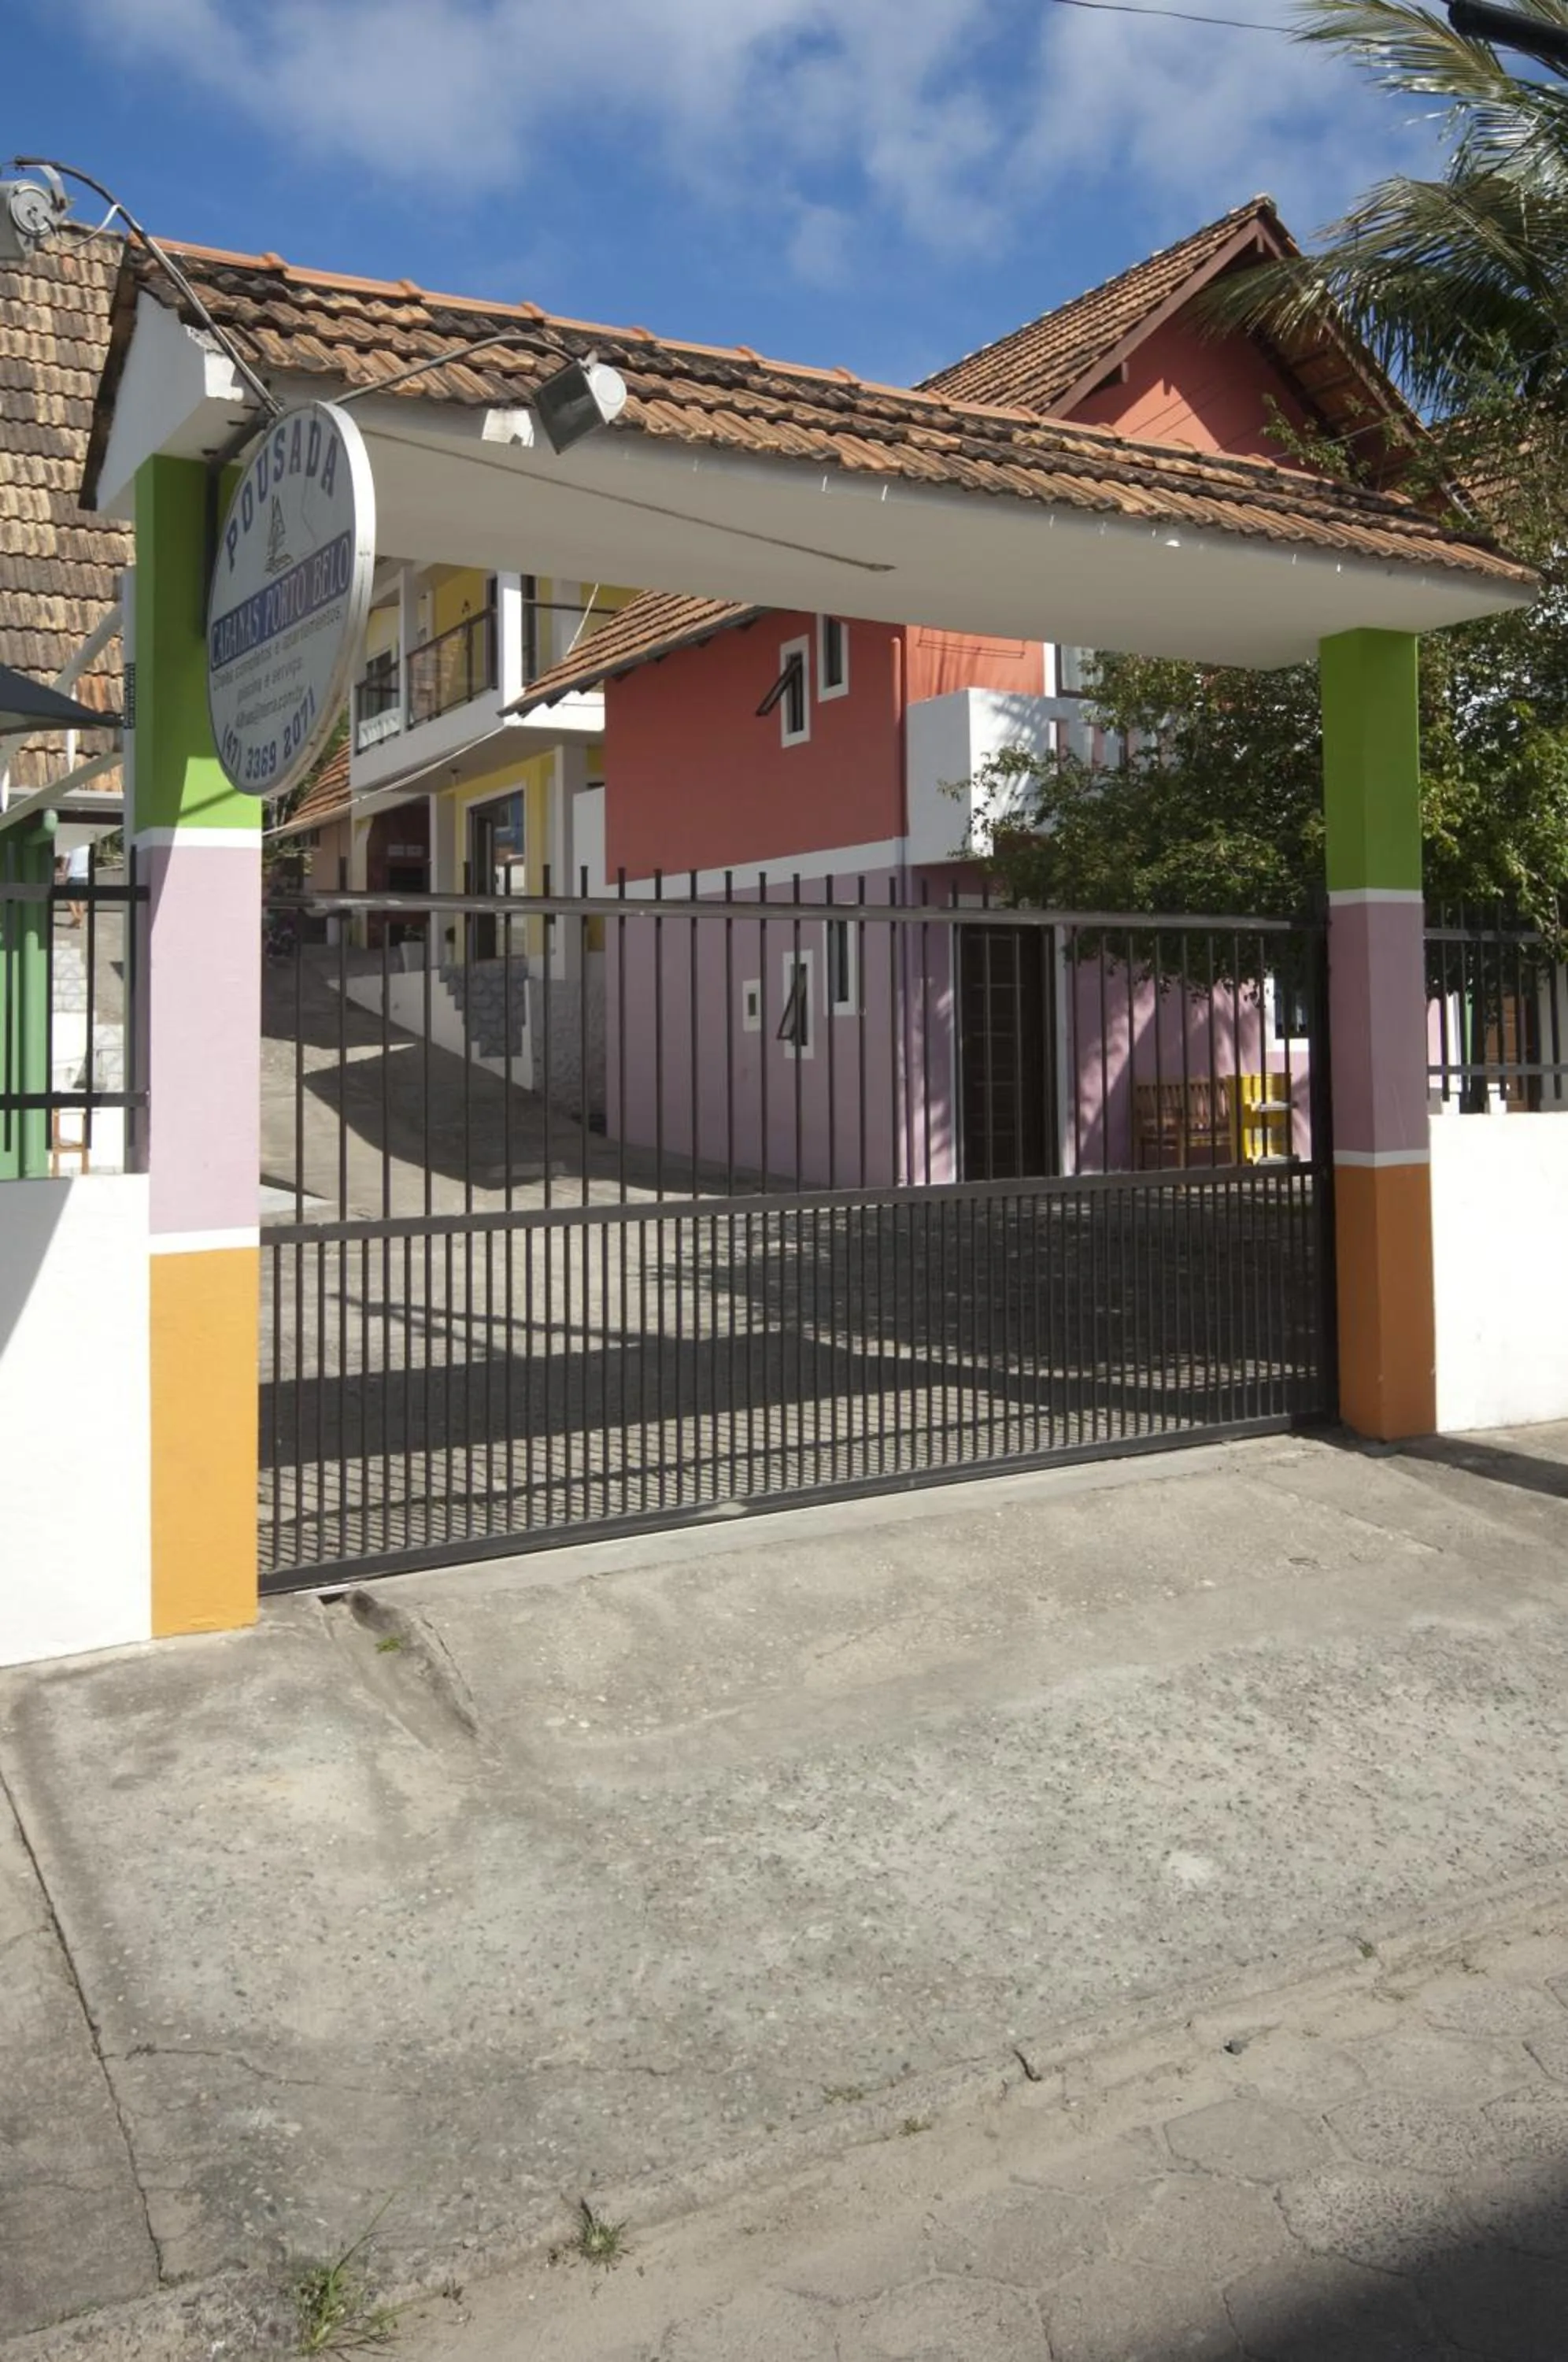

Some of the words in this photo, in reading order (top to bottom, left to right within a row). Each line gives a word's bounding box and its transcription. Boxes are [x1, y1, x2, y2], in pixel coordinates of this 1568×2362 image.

[226, 418, 338, 573] POUSADA
[212, 598, 259, 669] CABANAS
[264, 565, 307, 638] PORTO
[313, 537, 349, 606] BELO
[222, 724, 242, 776] (47)
[245, 740, 276, 780] 3369
[283, 685, 316, 760] 2071
